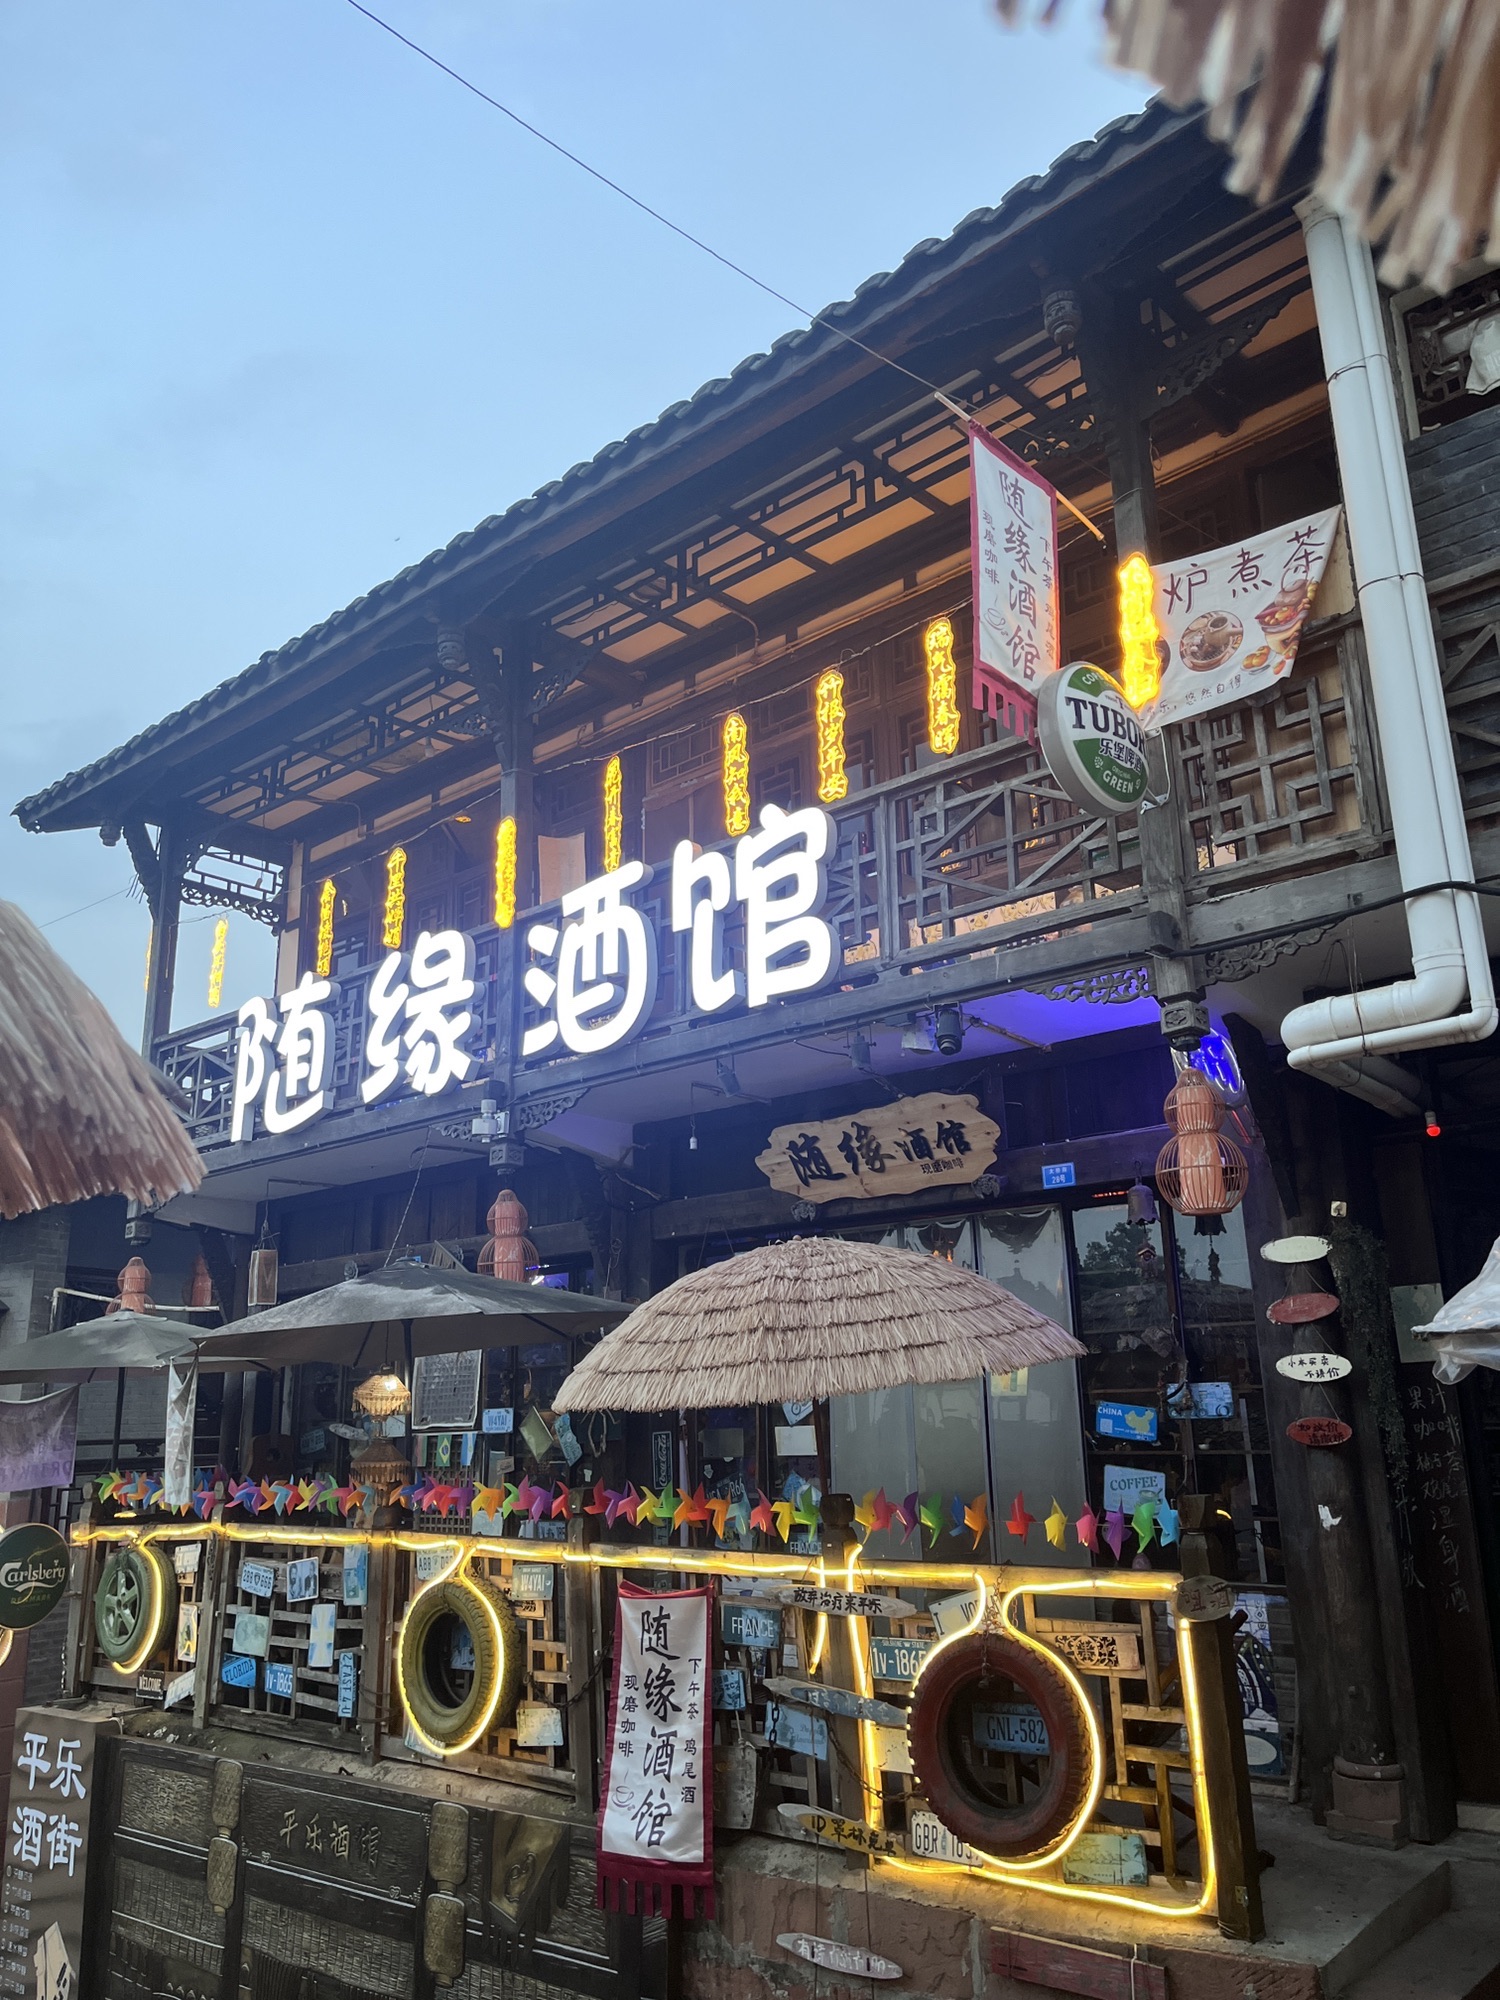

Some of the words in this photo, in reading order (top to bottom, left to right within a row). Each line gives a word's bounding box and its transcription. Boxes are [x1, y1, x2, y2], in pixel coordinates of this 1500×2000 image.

[983, 509, 1000, 585] 现磨咖啡
[1040, 536, 1053, 589] 下午茶
[998, 470, 1041, 682] 随缘酒馆
[1102, 770, 1134, 794] GREEN
[231, 803, 834, 1143] 随缘酒馆
[786, 1119, 973, 1188] 随缘酒馆
[1097, 1406, 1122, 1416] CHINA
[1409, 1383, 1446, 1413] 果汁
[1413, 1414, 1461, 1445] 咖啡
[1110, 1476, 1158, 1491] COFFEE
[0, 1560, 65, 1588] Carlsberg
[789, 1541, 822, 1554] FRANCE
[731, 1616, 775, 1638] FRANCE
[139, 1675, 162, 1692] WELCOME
[224, 1659, 254, 1683] FLORIDA
[687, 1658, 702, 1720] 下午茶
[618, 1675, 640, 1758] 现磨咖啡
[631, 1605, 682, 1848] 随缘酒馆
[17, 1732, 86, 1799] 平乐
[681, 1738, 698, 1804] 鸡尾酒
[12, 1806, 83, 1877] 酒街
